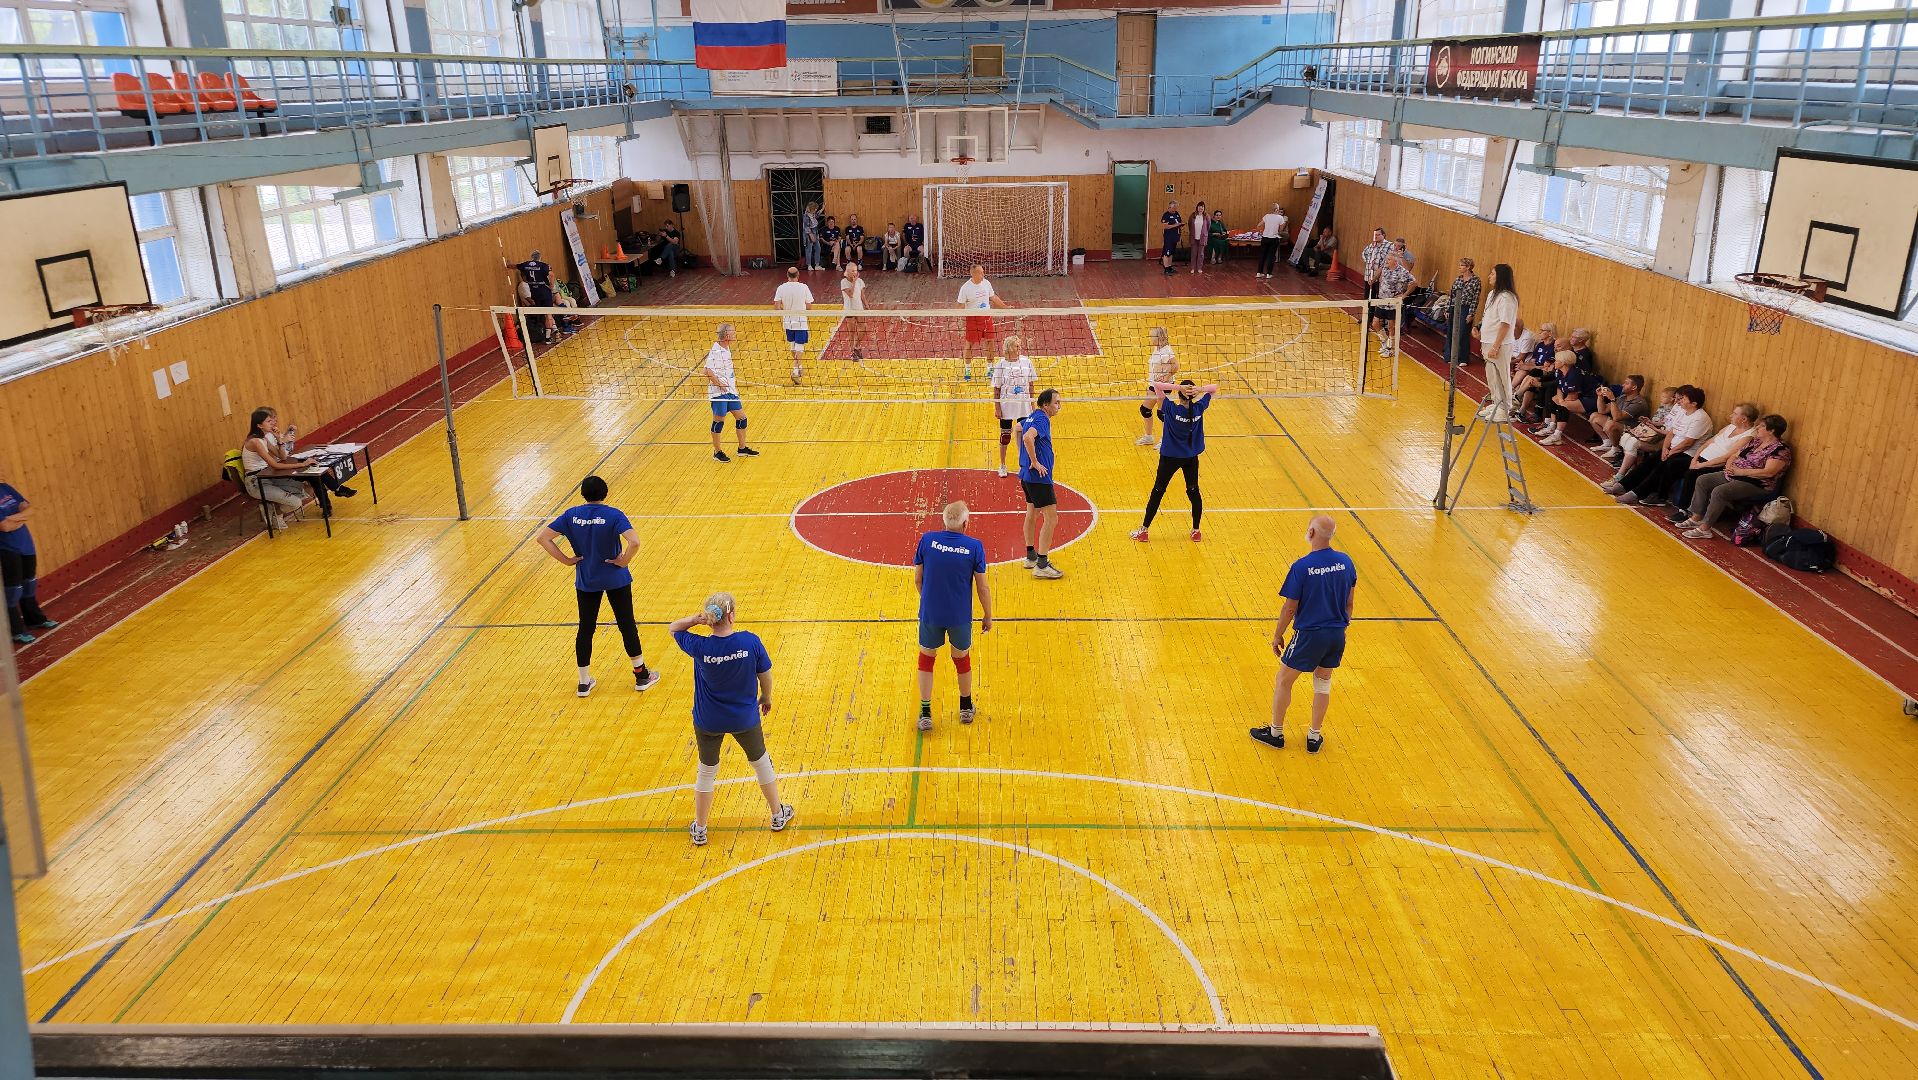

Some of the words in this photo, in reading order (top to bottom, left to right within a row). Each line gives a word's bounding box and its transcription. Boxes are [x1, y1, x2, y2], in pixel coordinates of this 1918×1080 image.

[1470, 45, 1518, 65] НОГИНСКАЯ
[1456, 70, 1501, 91] ФЕДЕРАЦИЯ
[335, 465, 343, 480] 8
[347, 457, 354, 472] 5
[572, 516, 606, 527] Королёв
[931, 540, 970, 555] Королёв
[1307, 562, 1346, 576] Королёв
[703, 649, 749, 665] Королёв
